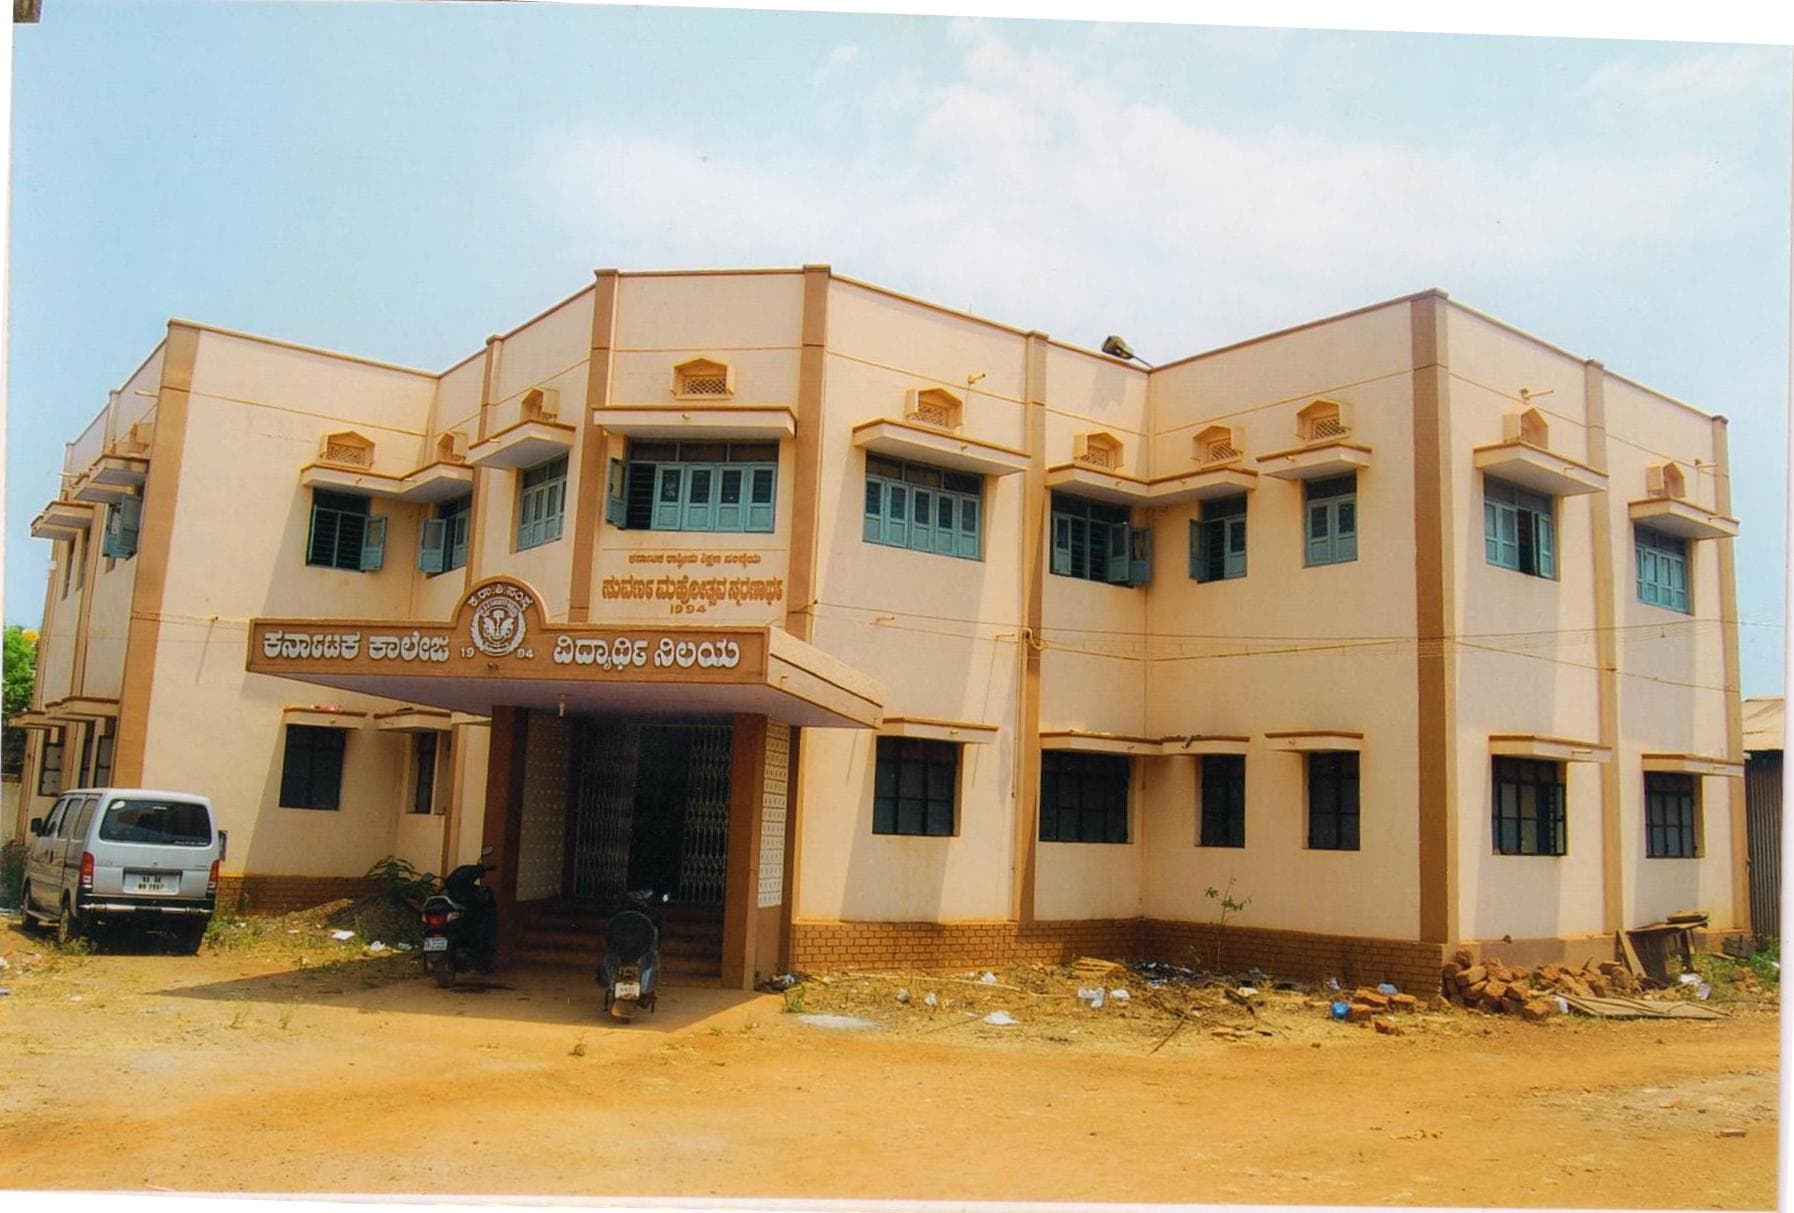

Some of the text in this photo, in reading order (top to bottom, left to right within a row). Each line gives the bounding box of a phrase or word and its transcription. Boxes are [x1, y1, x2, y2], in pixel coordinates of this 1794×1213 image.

[602, 575, 654, 600] ಸುವರ್ಣ
[656, 575, 726, 606] ಮಹೋತ್ಸವ
[670, 604, 706, 615] 1994
[263, 630, 360, 660] ಕರ್ನಾಟಕ
[553, 635, 648, 672] ವಿದ್ಯಾರ್ಥಿ
[654, 637, 740, 669] ನಿಲಯ
[461, 646, 475, 658] 19
[517, 647, 534, 659] 94
